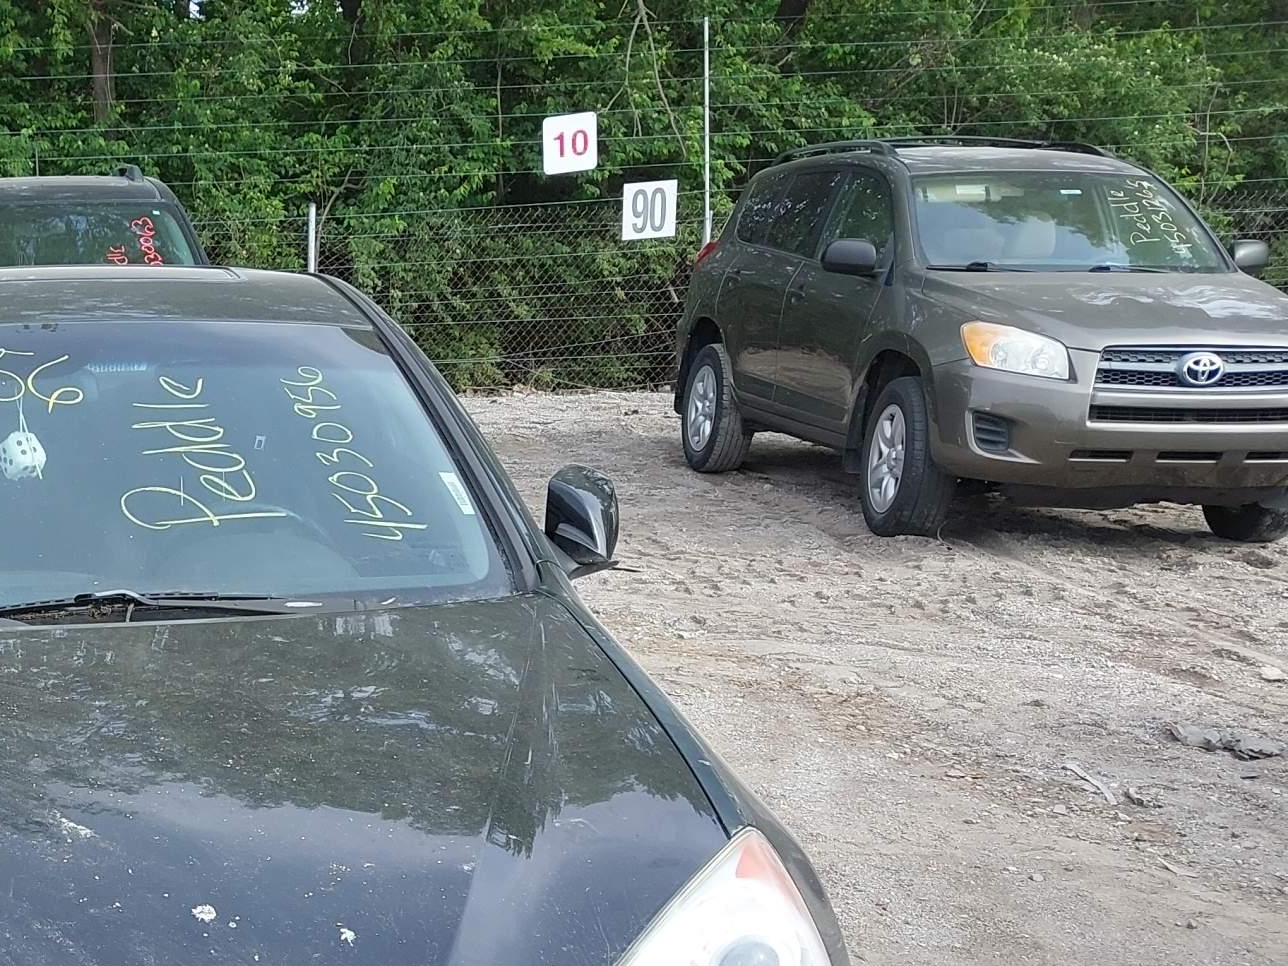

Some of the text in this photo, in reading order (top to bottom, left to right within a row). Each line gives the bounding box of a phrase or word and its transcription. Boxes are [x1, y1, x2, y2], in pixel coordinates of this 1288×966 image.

[553, 129, 589, 158] 10
[631, 187, 667, 234] 90
[1107, 190, 1161, 245] Peddle
[120, 376, 288, 530] Peddle
[279, 366, 428, 541] 45030956
